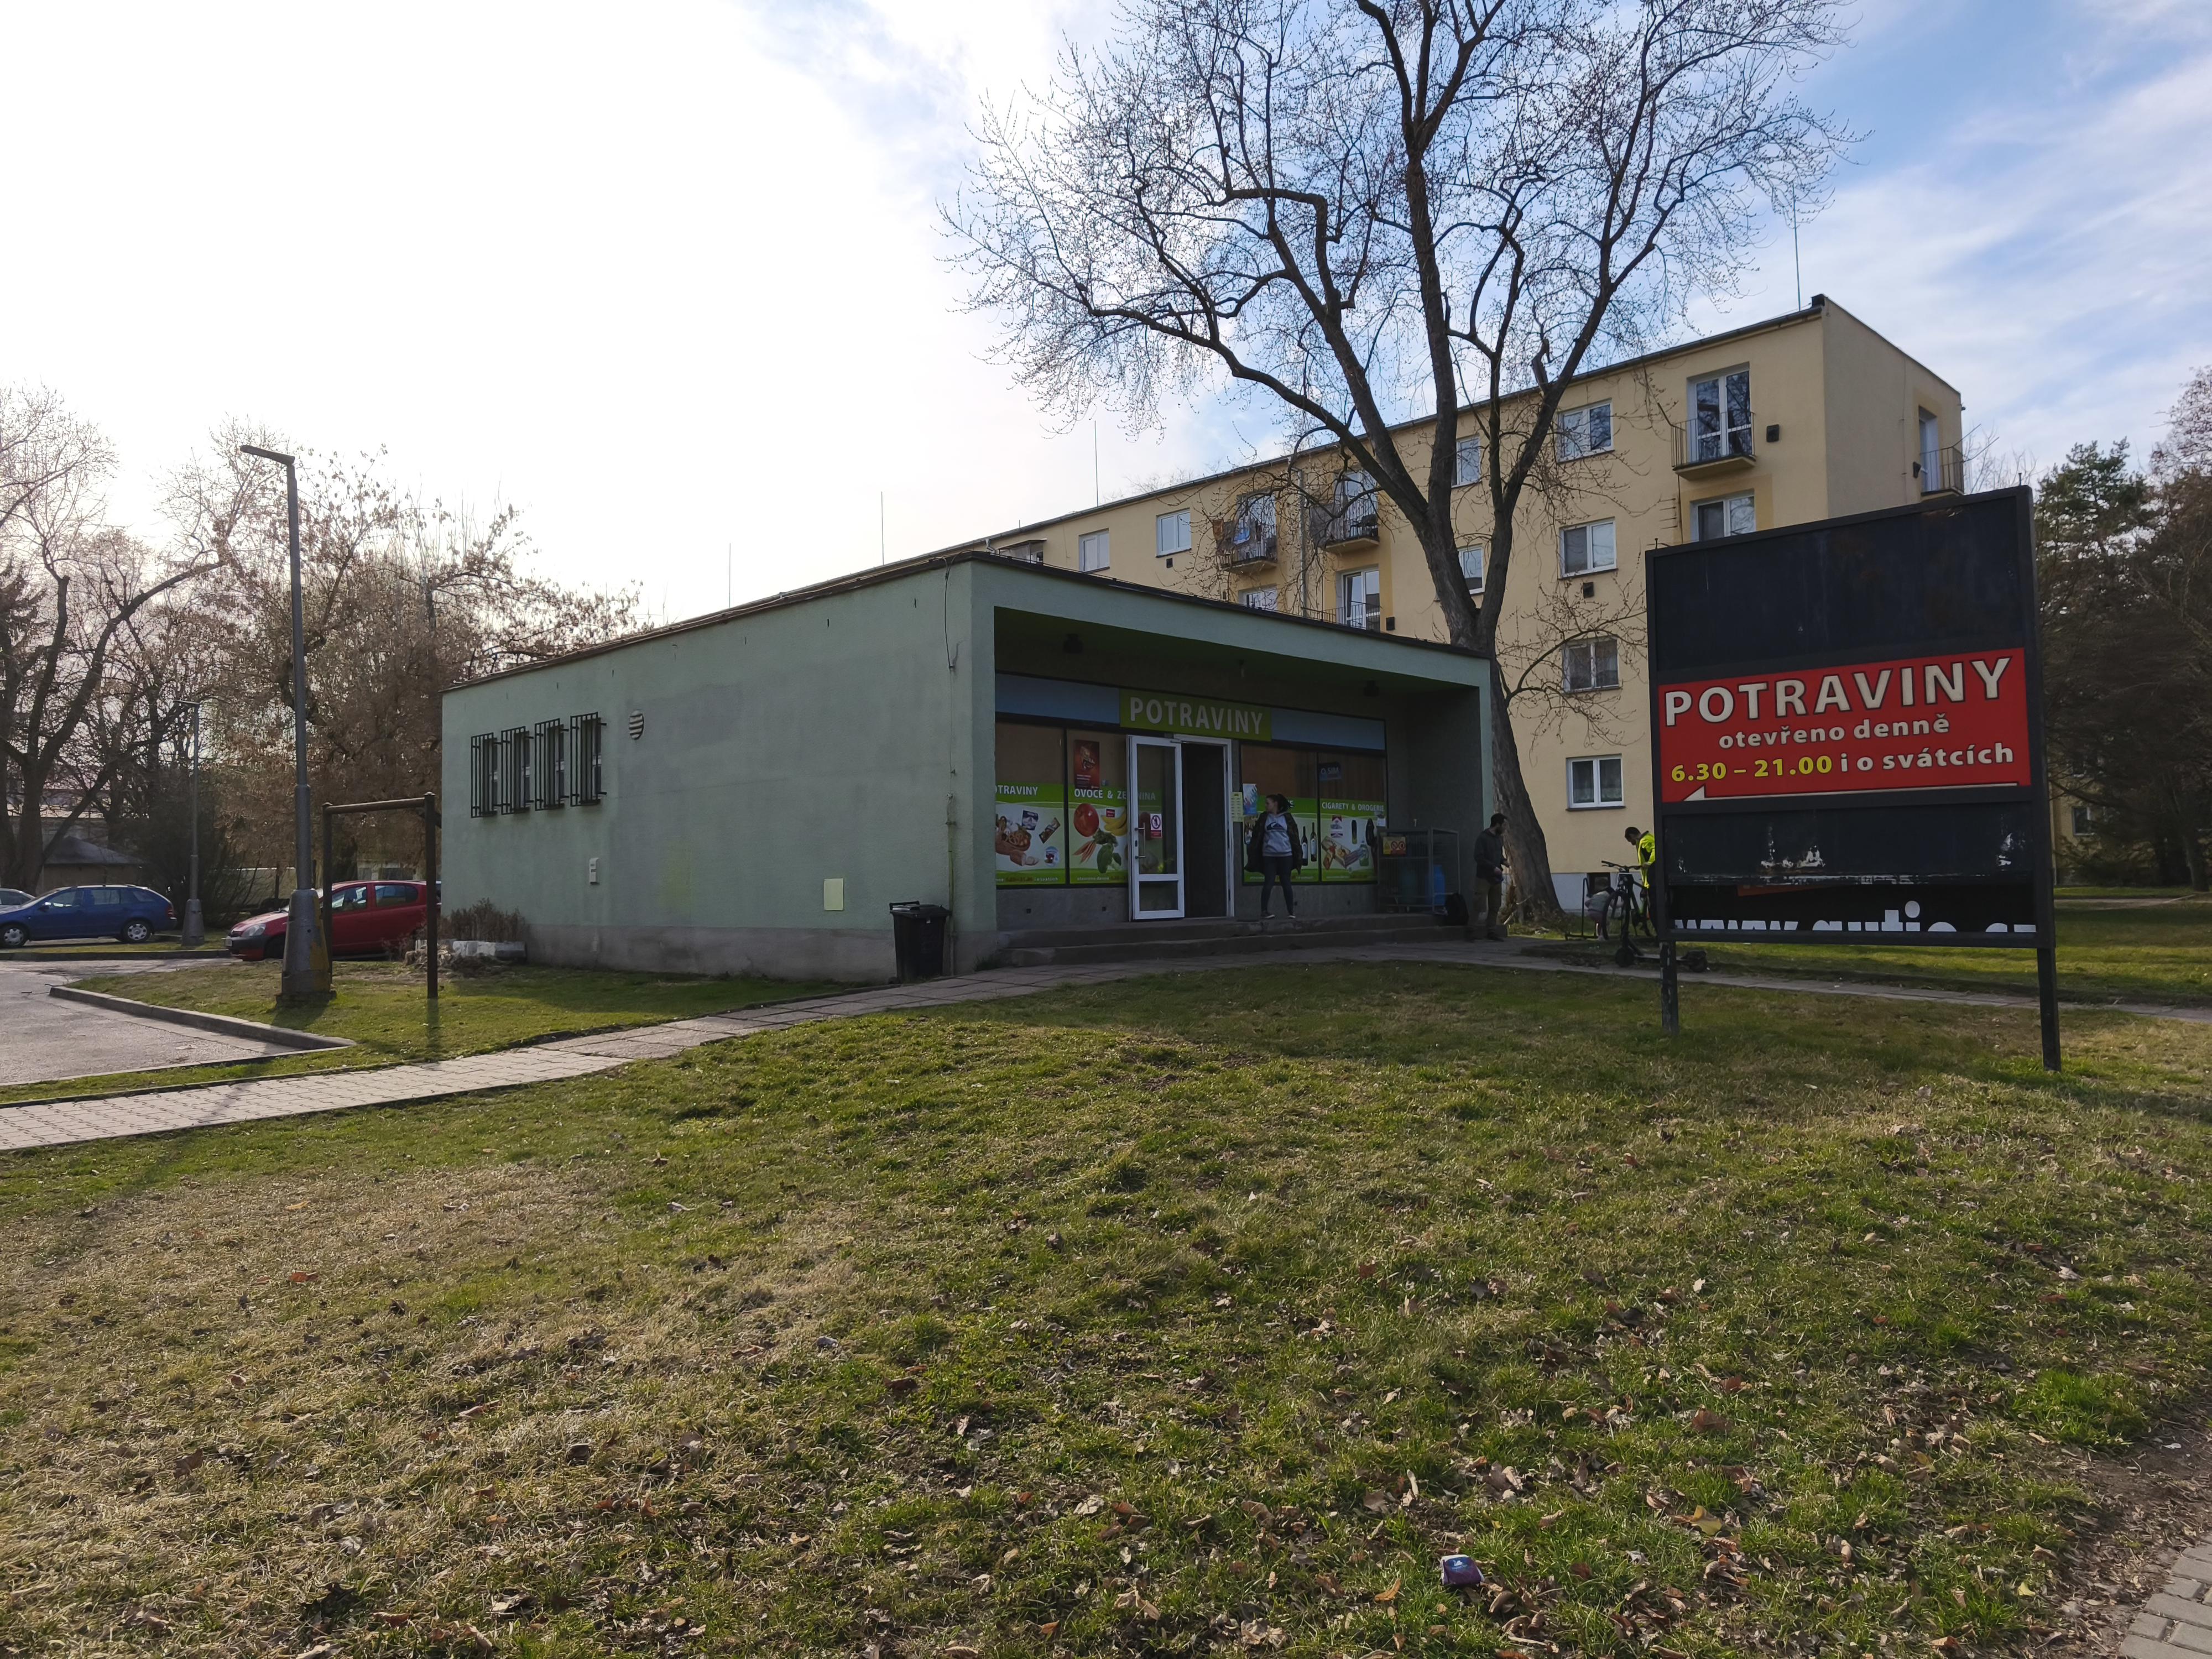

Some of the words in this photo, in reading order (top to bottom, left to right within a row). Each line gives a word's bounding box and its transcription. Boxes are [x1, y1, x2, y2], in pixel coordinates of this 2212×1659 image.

[1665, 658, 2011, 726] POTRAVINY
[1130, 697, 1264, 734] POTRAVINY
[1718, 725, 1845, 749] otevřeno
[1853, 713, 1950, 739] denně
[1671, 763, 1726, 782] 6.30
[1754, 754, 1833, 777] 21.00
[1840, 753, 1848, 772] i
[1856, 757, 1874, 771] o
[1882, 742, 2013, 770] svátcích
[1074, 789, 1103, 799] OVOCE
[1107, 790, 1113, 799] &
[1322, 802, 1349, 810] CIGARETY
